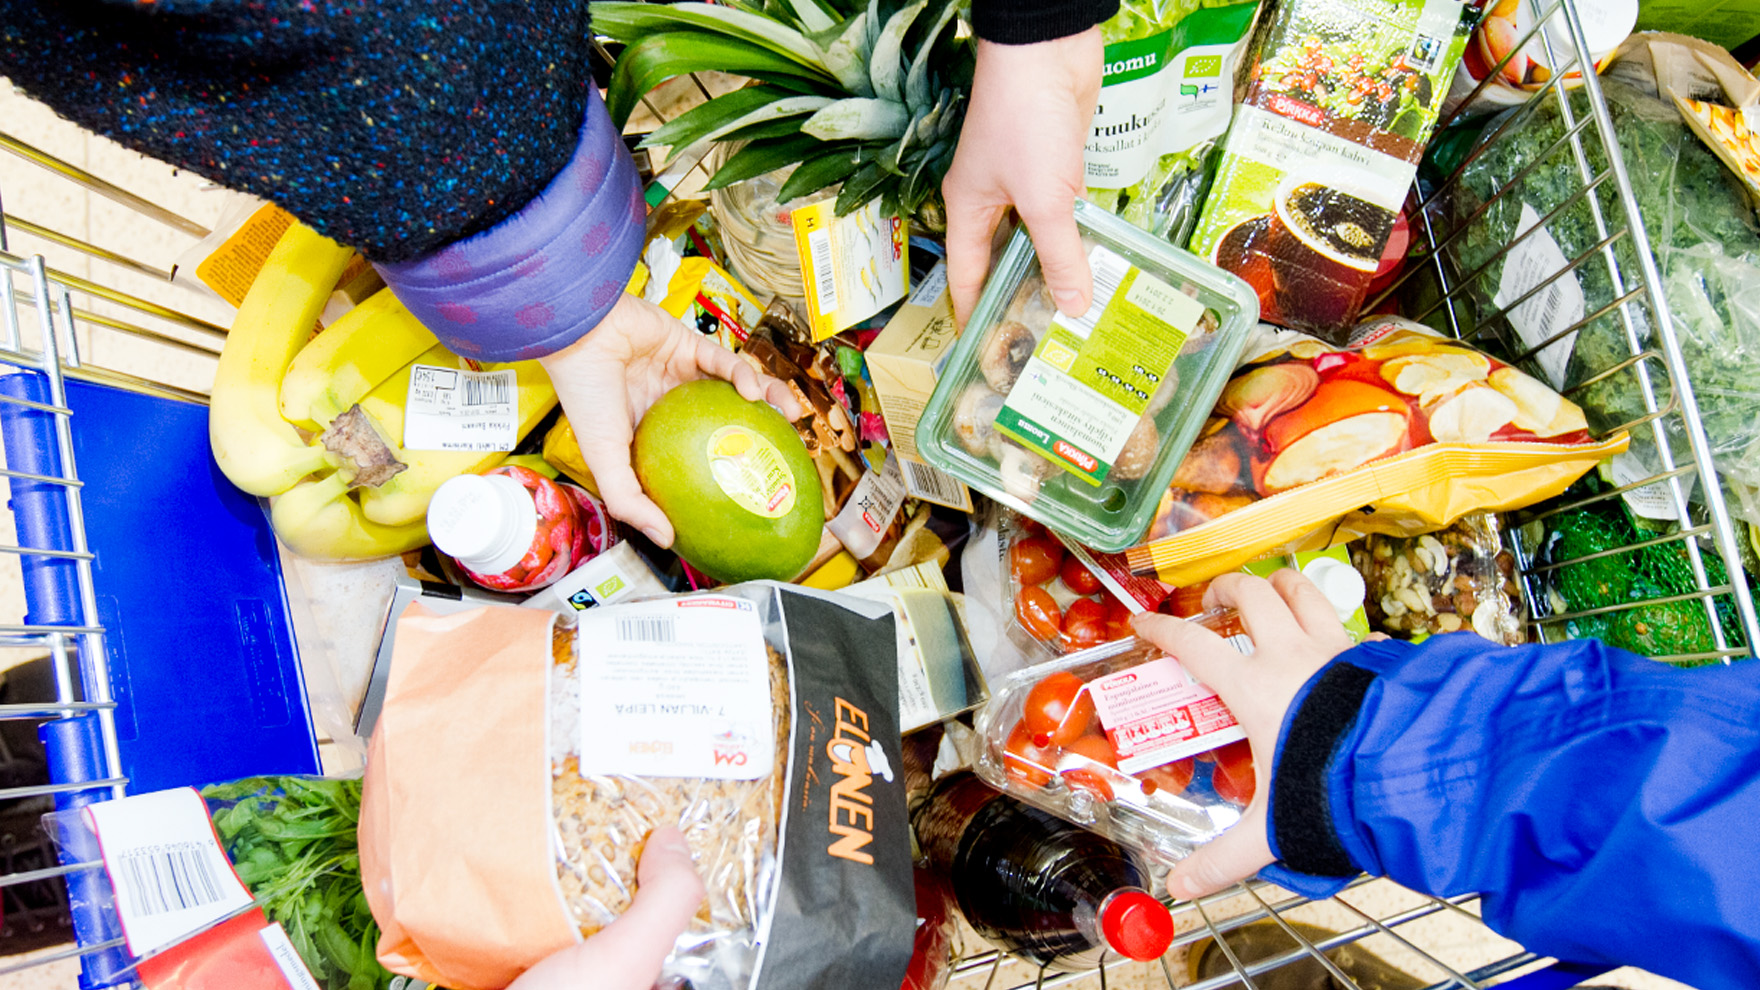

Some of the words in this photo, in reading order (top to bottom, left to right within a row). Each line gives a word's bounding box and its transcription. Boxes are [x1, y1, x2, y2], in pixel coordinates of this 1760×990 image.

[1100, 51, 1157, 76] uomu
[891, 216, 904, 260] Dole
[614, 703, 655, 714] LEIPÄ
[718, 706, 724, 716] 7
[826, 697, 875, 866] ELONEN
